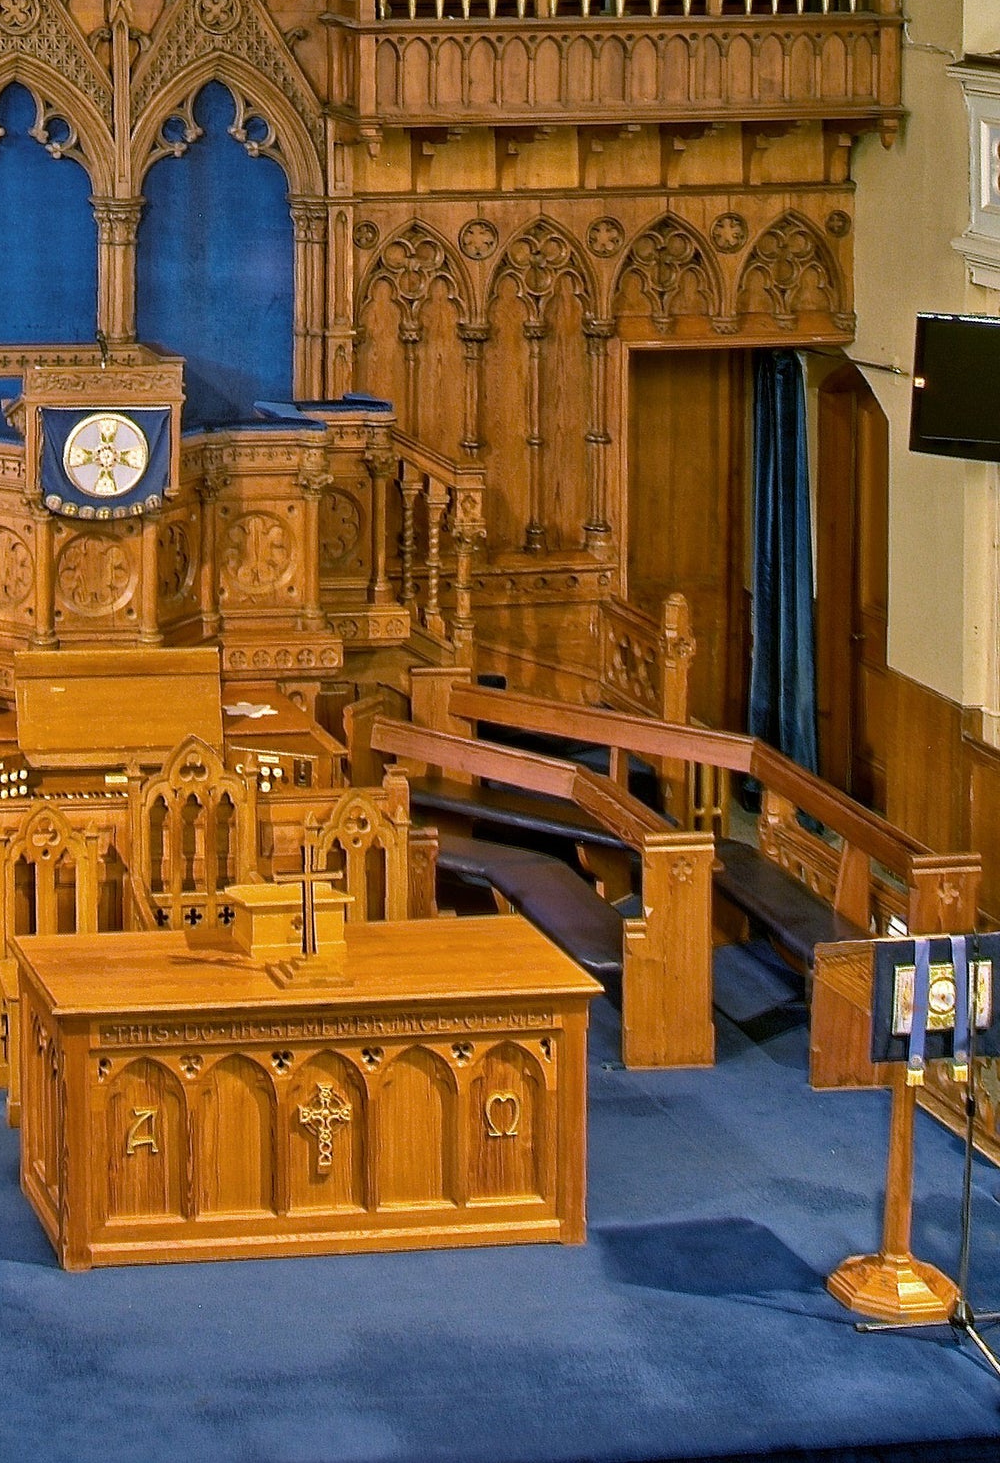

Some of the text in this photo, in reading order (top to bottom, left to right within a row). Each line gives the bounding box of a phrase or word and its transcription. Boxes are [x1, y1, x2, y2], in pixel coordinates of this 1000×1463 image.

[113, 1024, 169, 1043] THIS
[183, 1022, 214, 1041] DO
[269, 1012, 450, 1038] REMEMBRANCE
[464, 1012, 493, 1030] OF
[508, 1009, 540, 1028] ME
